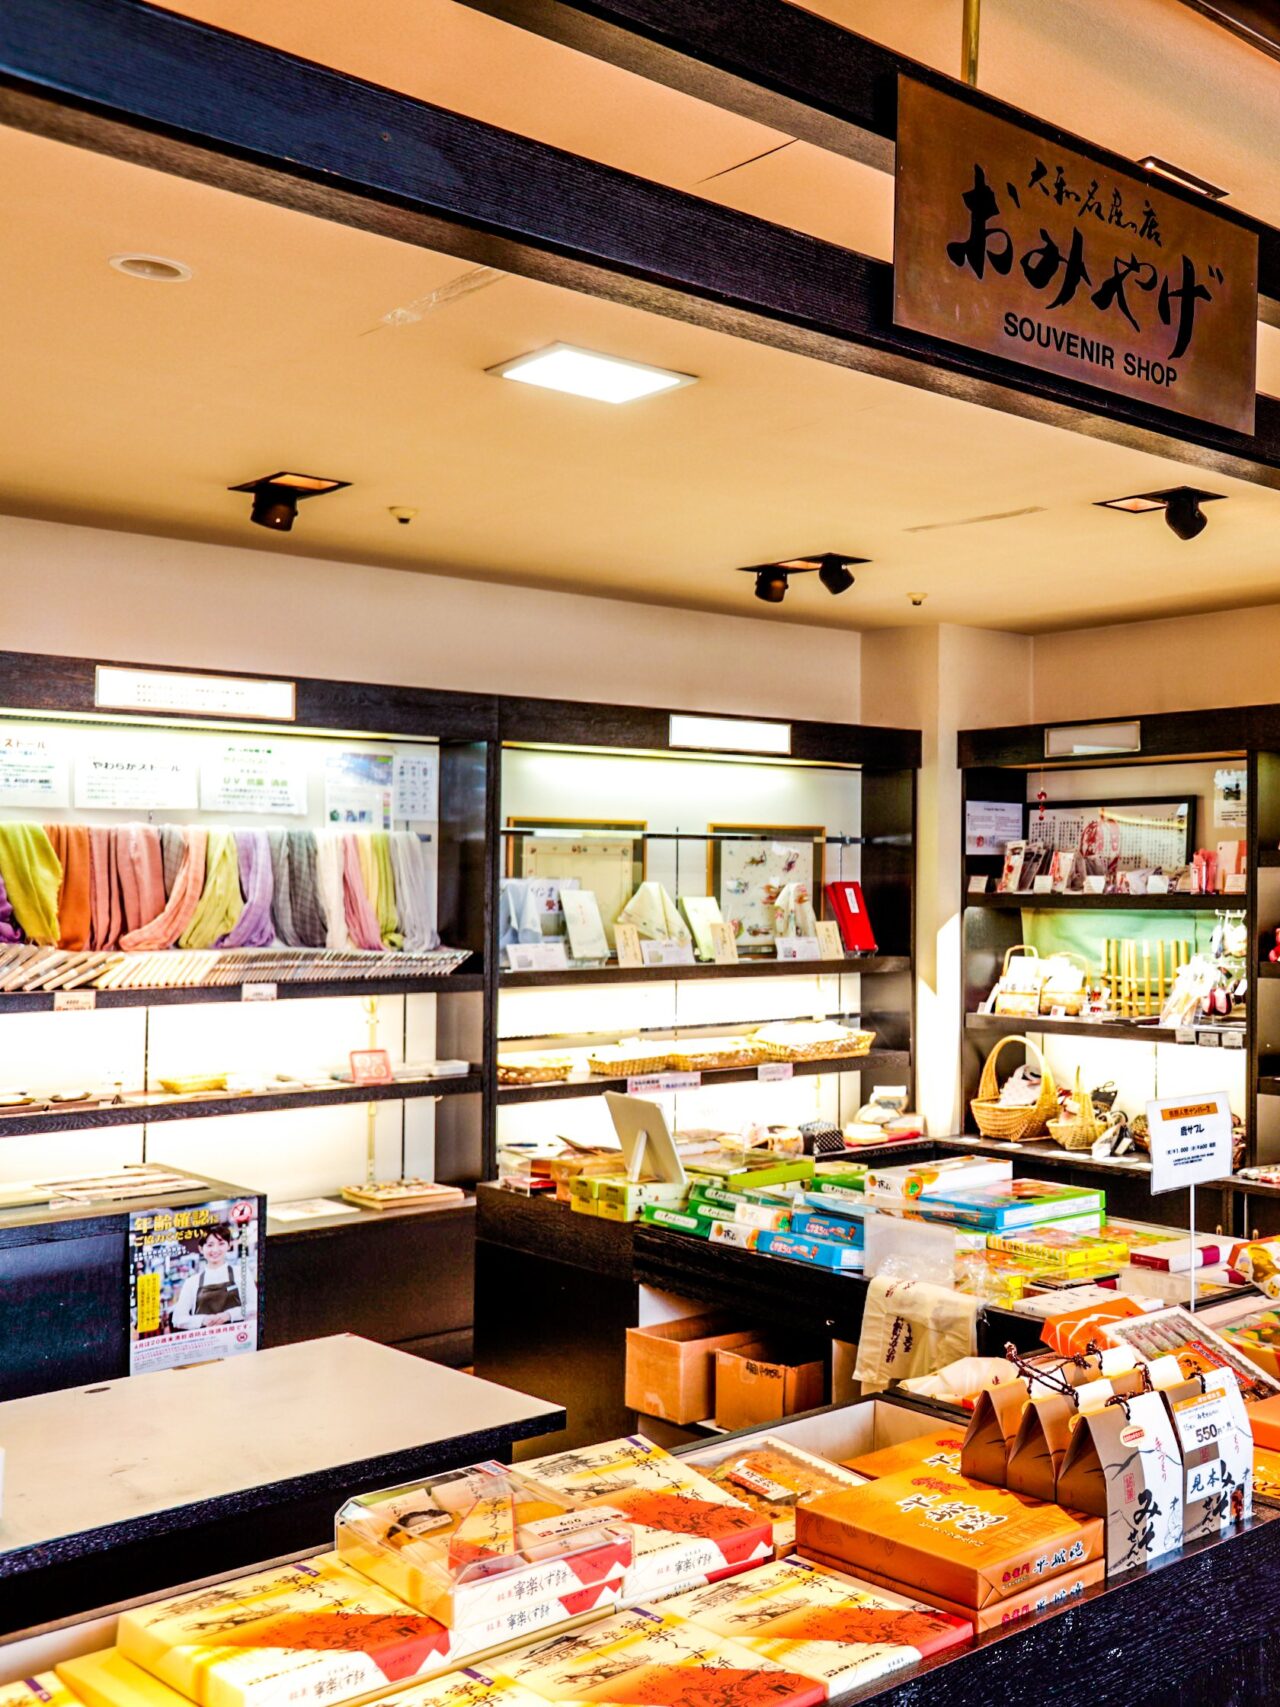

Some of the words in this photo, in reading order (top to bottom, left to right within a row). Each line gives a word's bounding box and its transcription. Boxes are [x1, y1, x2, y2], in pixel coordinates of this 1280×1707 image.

[946, 163, 1225, 361] おみやげ
[1004, 312, 1114, 370] SOUVENIR
[1123, 353, 1177, 388] SHOP
[134, 1209, 218, 1234] 年齢確認に
[1190, 1468, 1220, 1494] 見本
[1133, 1489, 1162, 1552] みそ
